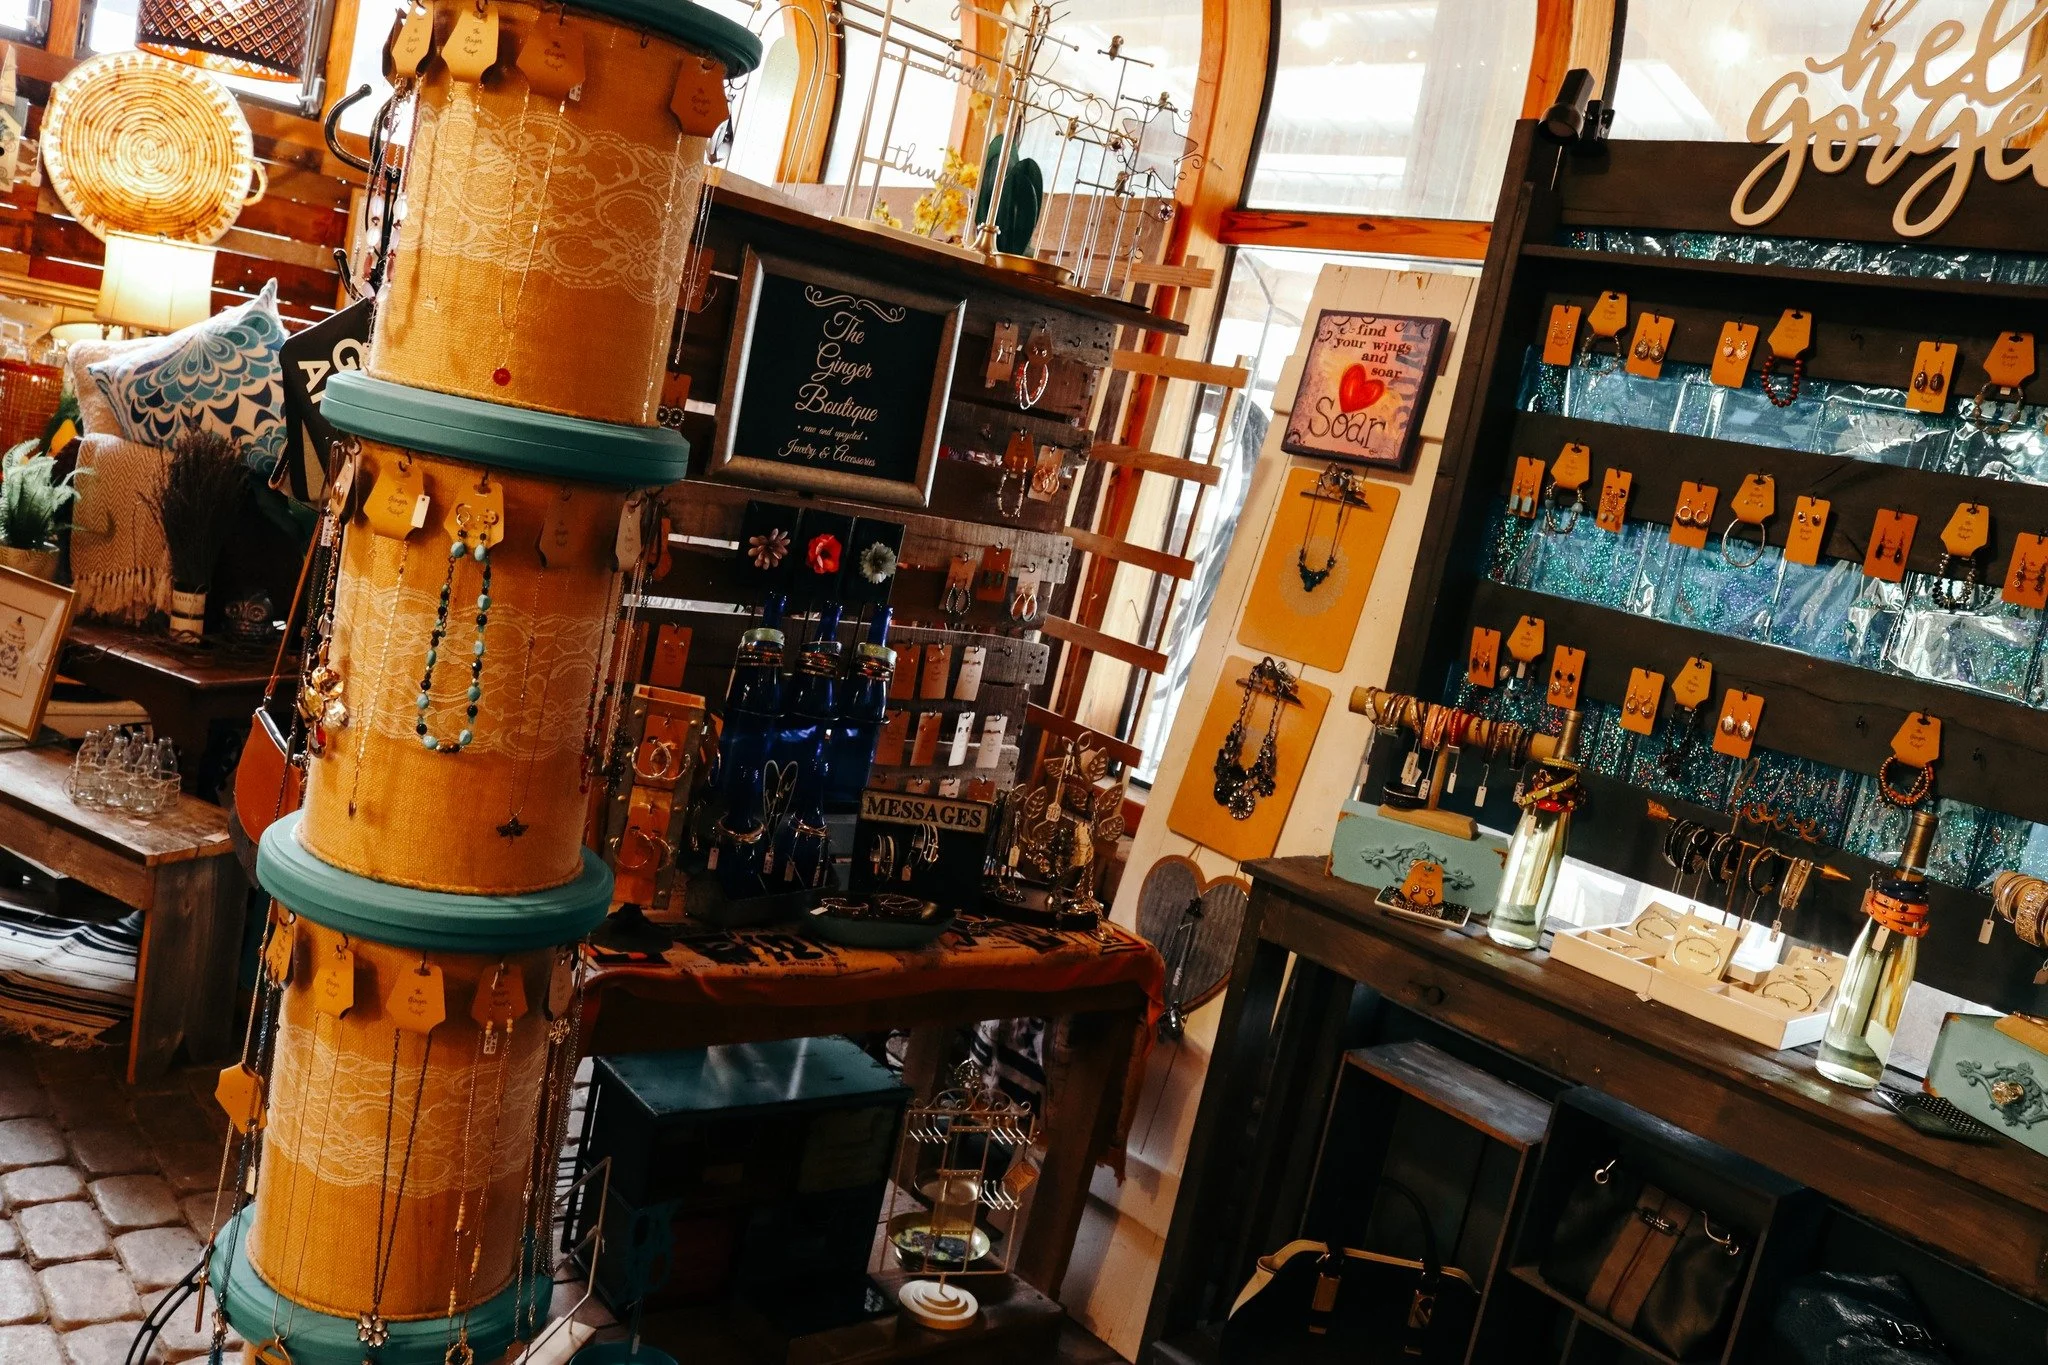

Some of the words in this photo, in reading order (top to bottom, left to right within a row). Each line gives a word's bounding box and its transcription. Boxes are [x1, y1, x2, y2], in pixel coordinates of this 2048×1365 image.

[823, 311, 865, 344] The
[1355, 323, 1387, 337] find
[1333, 337, 1367, 349] your
[1372, 340, 1413, 356] wings
[1360, 352, 1389, 365] and
[810, 342, 873, 386] Ginger
[1370, 367, 1402, 380] soar
[794, 383, 879, 427] Boutique
[802, 425, 816, 435] new
[819, 426, 832, 437] and
[834, 429, 863, 442] upcycled
[1307, 395, 1387, 449] Soar
[778, 438, 817, 460] Jewelry
[819, 447, 830, 459] &
[832, 444, 877, 468] Accessories
[866, 795, 983, 828] MESSAGES
[1730, 756, 1828, 845] love
